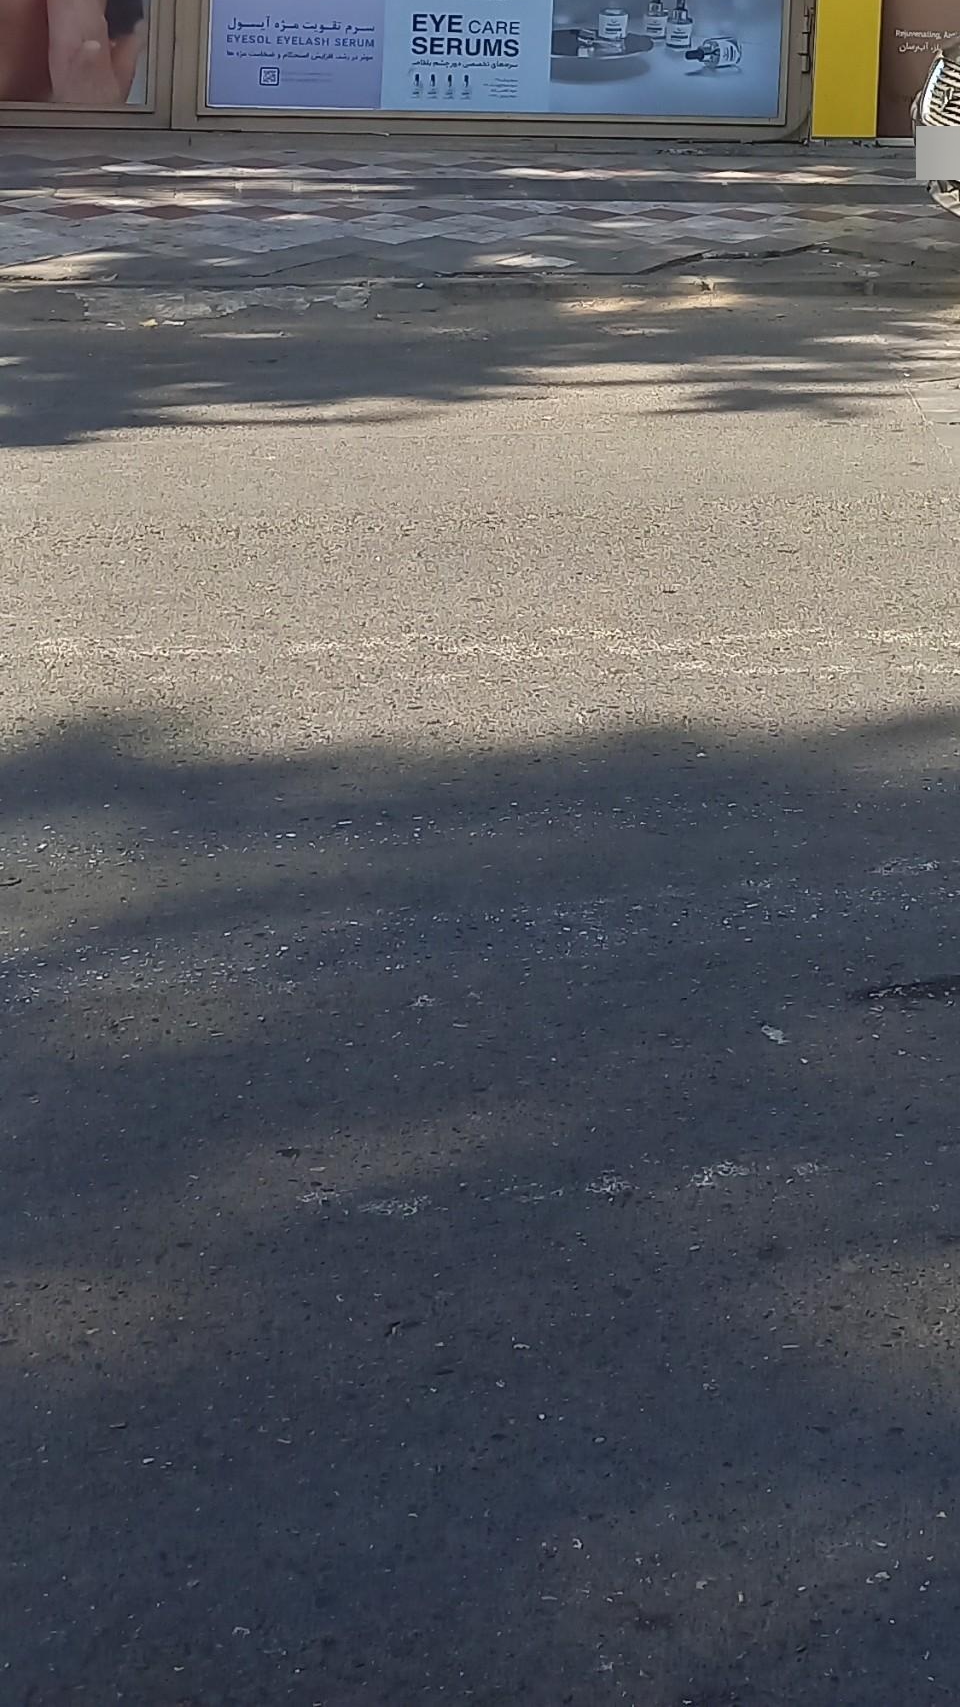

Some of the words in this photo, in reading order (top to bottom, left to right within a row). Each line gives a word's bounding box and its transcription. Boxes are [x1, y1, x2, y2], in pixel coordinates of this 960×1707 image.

[345, 24, 375, 35] سرم
[412, 14, 463, 33] EYE
[468, 20, 520, 35] CARE
[226, 34, 271, 44] EYESOL
[276, 36, 330, 46] EYELASH
[334, 37, 375, 47] SERUM
[411, 36, 520, 57] SERUMS
